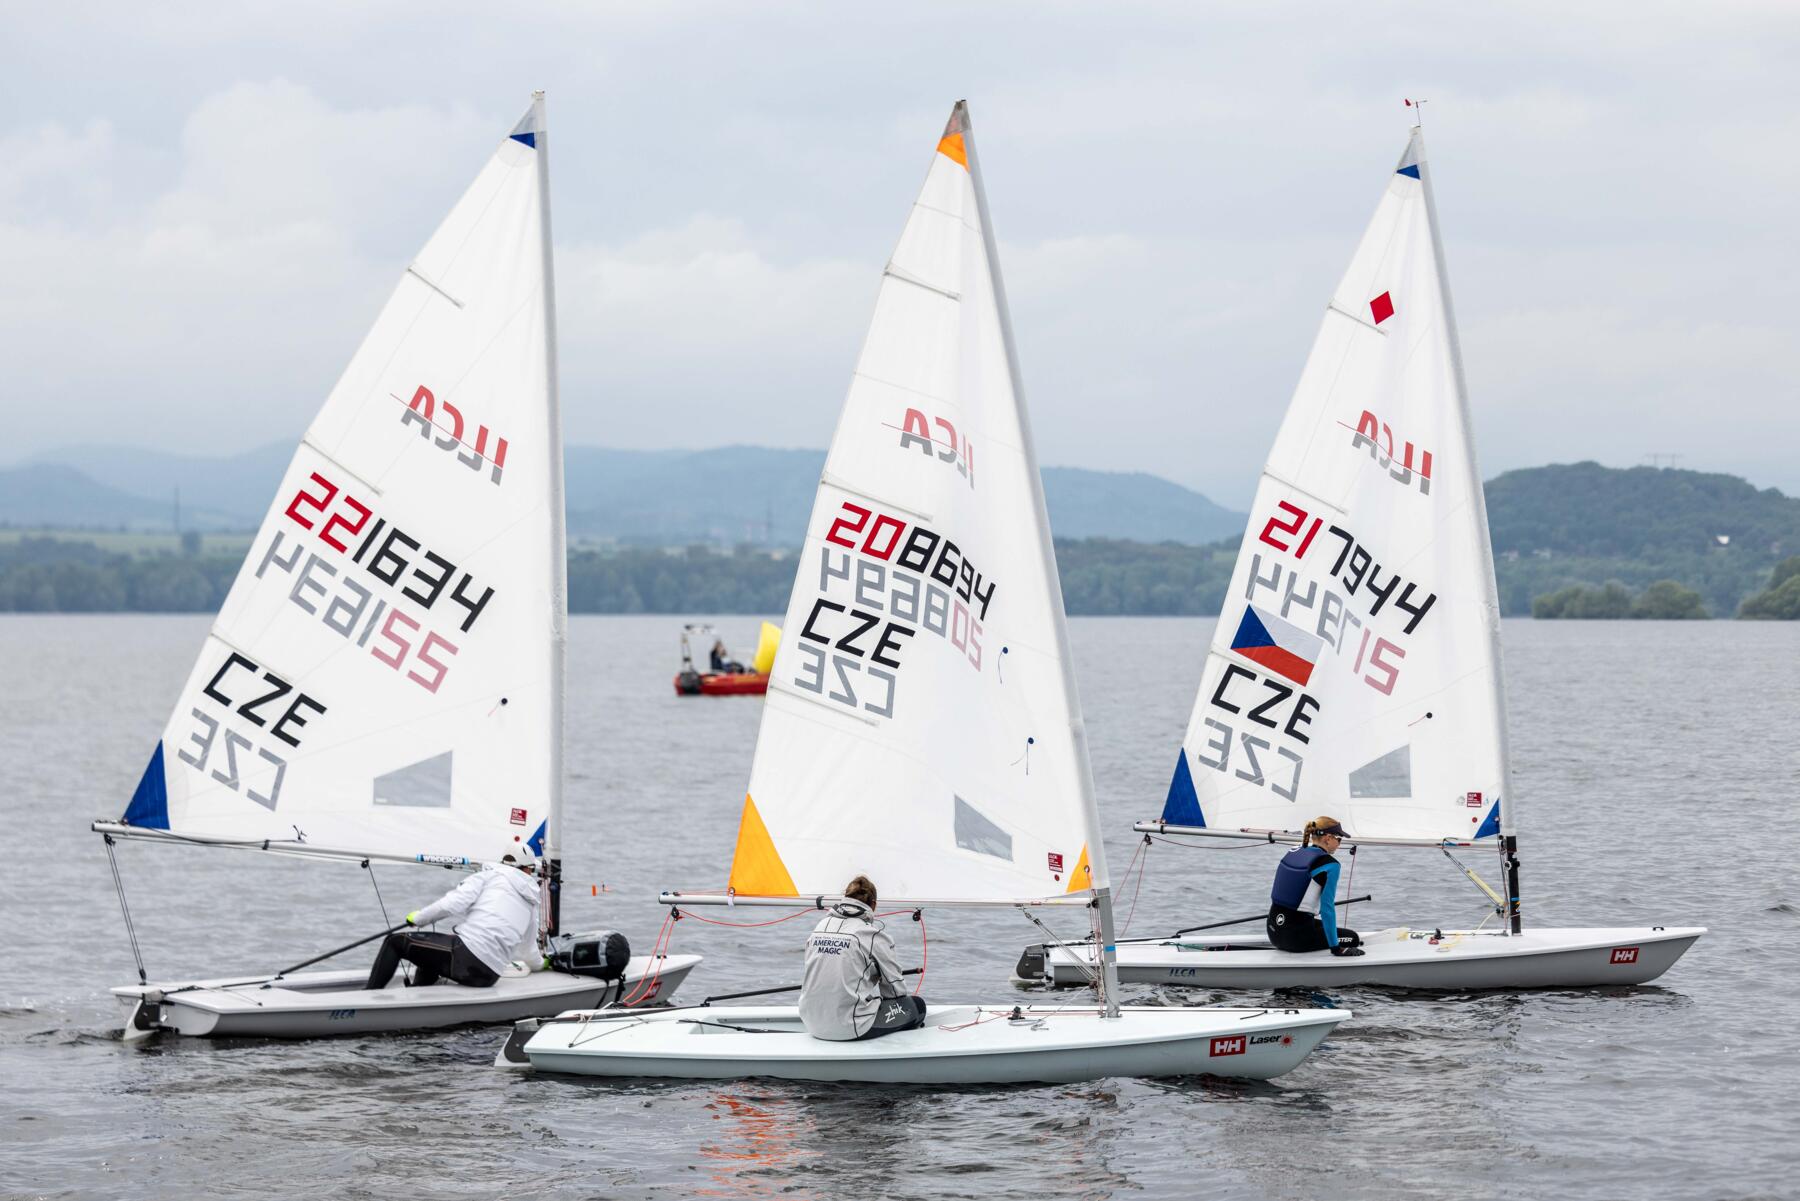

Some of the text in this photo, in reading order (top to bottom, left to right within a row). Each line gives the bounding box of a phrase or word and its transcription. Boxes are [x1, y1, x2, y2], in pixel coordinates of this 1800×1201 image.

[284, 471, 495, 633] 221634
[825, 501, 996, 621] 208694
[1259, 500, 1437, 635] 217944
[800, 598, 915, 669] CZE
[203, 652, 327, 748] CZE
[1211, 663, 1321, 745] CZE
[813, 940, 851, 949] AMERICAN
[818, 947, 842, 955] MAGIC
[1168, 968, 1196, 977] ILCA
[1613, 949, 1636, 962] HH
[1213, 1034, 1282, 1054] HH Laser
